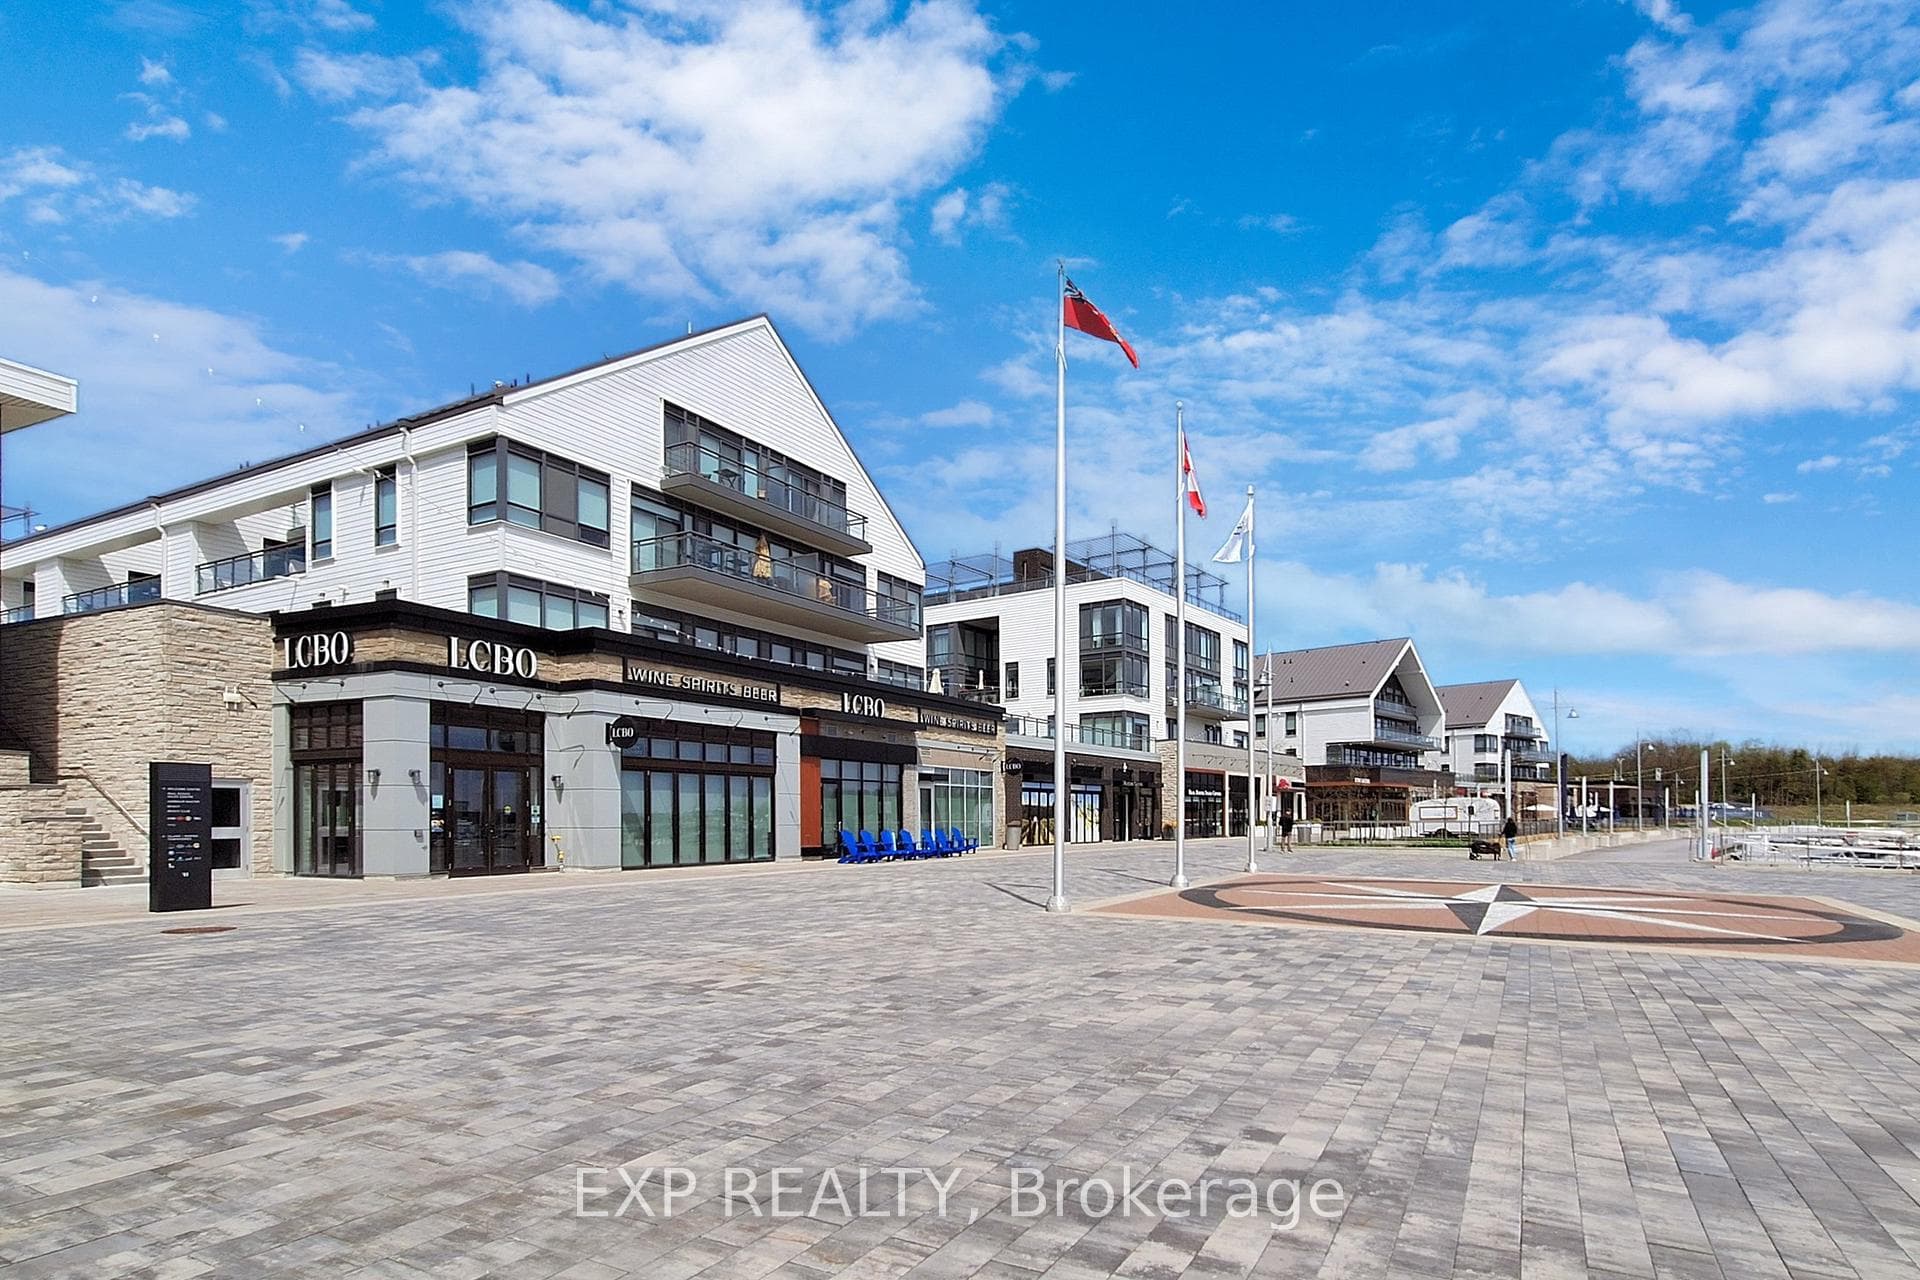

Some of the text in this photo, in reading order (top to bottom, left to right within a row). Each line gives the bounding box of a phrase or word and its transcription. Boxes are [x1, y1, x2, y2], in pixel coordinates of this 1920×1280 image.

[283, 631, 349, 669] LCBO
[450, 636, 538, 679] LCBO
[629, 667, 778, 702] WINE SPIRITS BEER
[843, 692, 885, 718] LCBO
[612, 727, 634, 738] LCBO
[921, 713, 996, 734] WINE SPIRITS BEER
